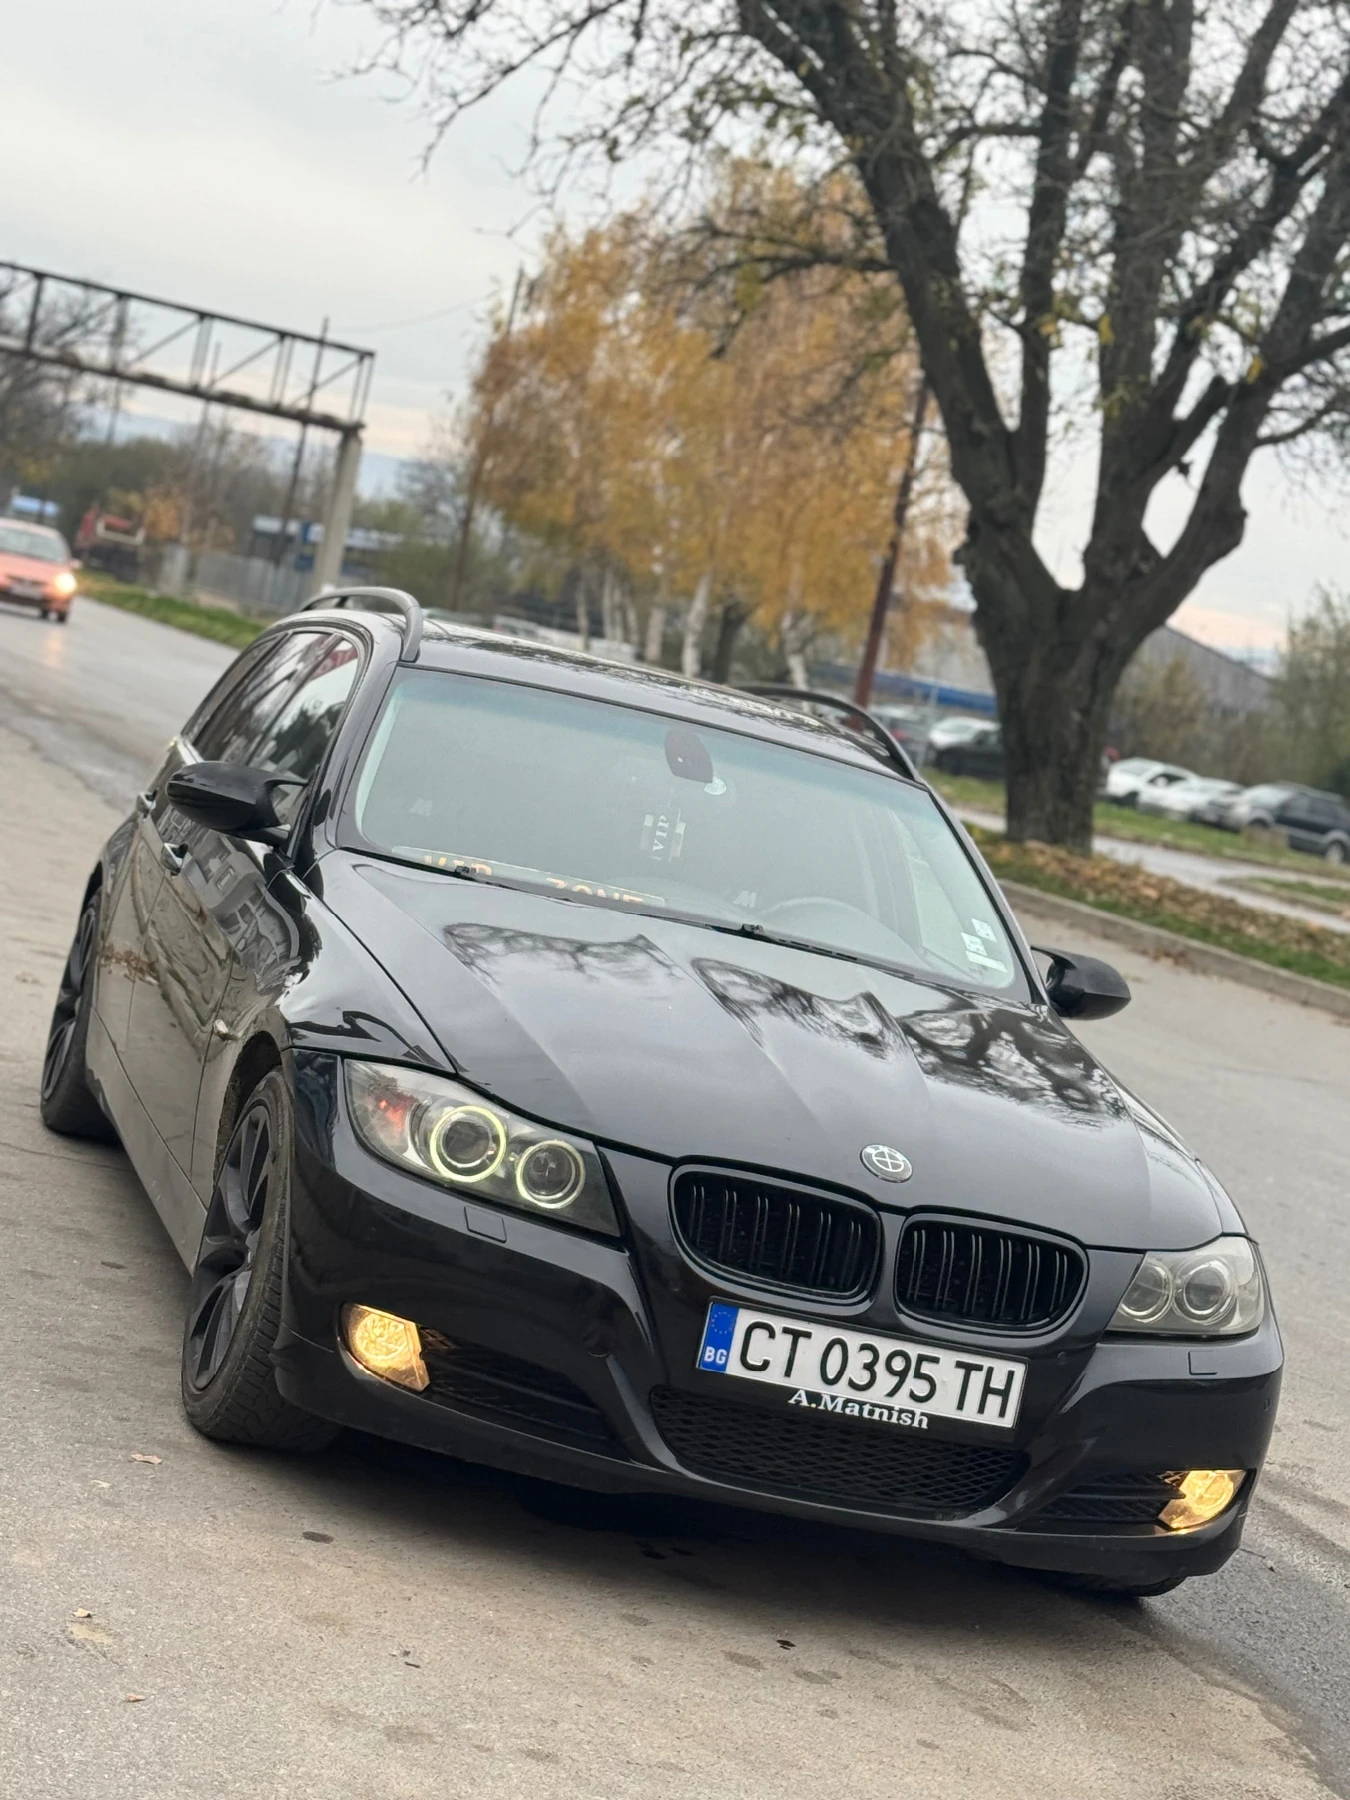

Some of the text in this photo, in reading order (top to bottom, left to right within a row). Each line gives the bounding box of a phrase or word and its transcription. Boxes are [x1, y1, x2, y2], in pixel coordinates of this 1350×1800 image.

[703, 1346, 727, 1365] BG
[740, 1320, 1016, 1419] CT 0395 TH
[788, 1388, 929, 1429] A.Matnish
